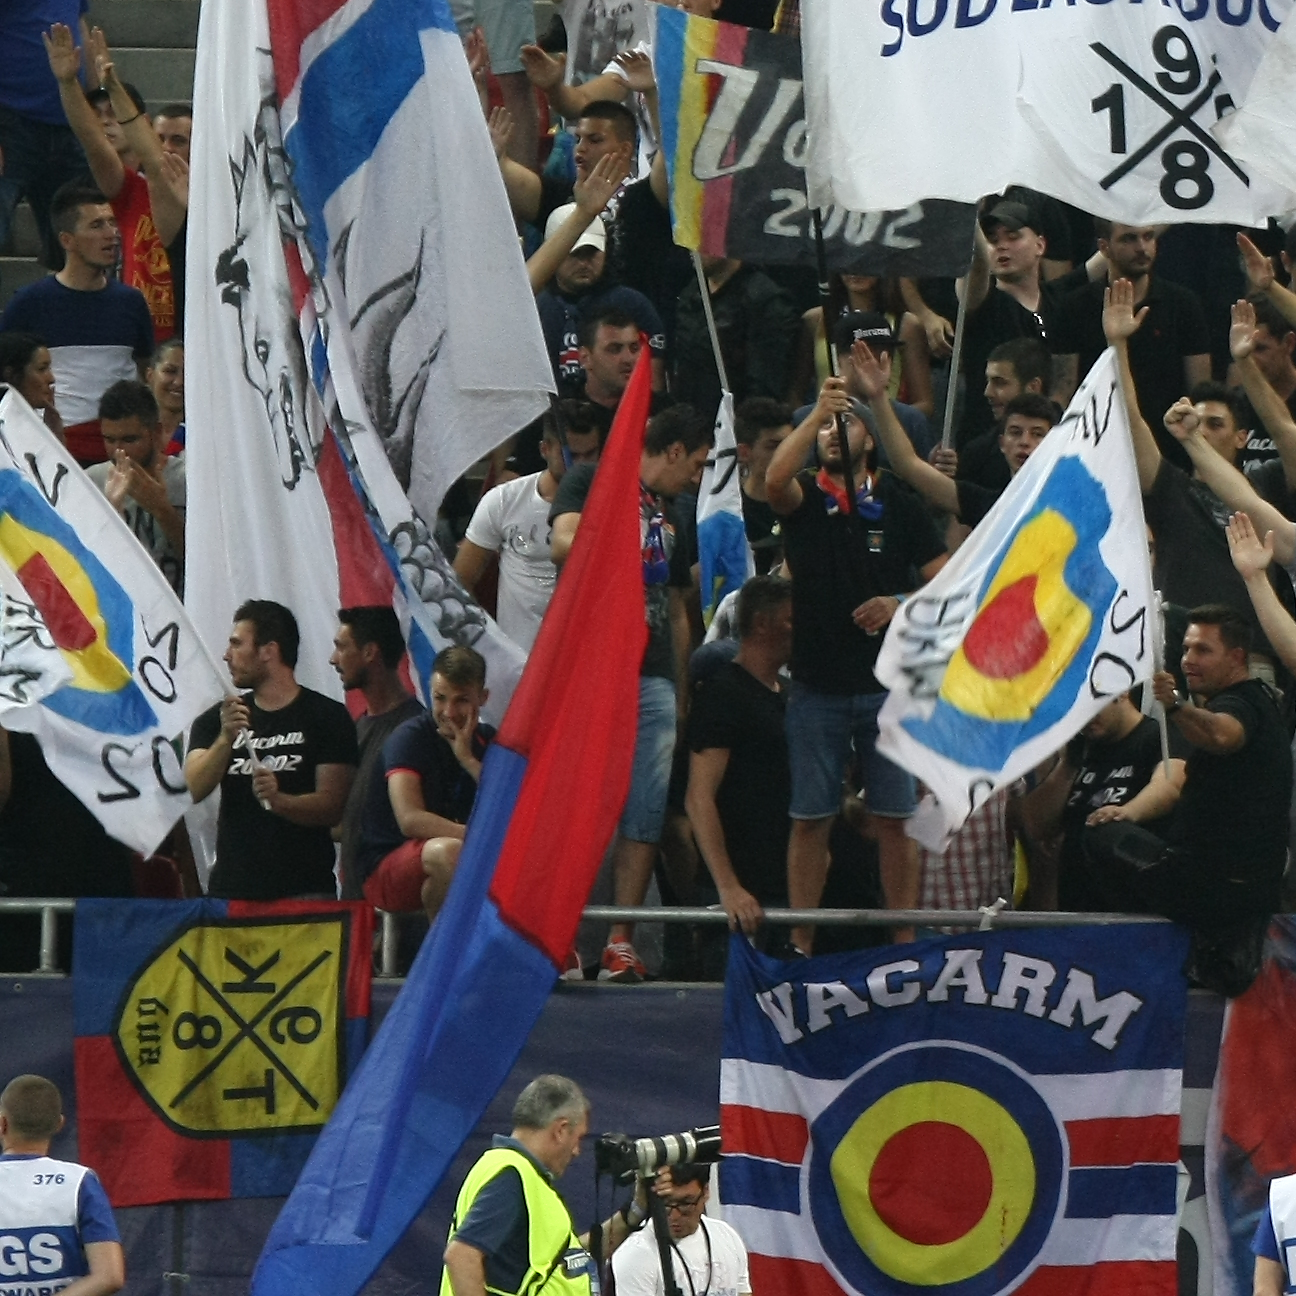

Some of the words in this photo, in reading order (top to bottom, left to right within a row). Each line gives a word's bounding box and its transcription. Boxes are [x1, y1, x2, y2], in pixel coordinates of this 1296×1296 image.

[755, 946, 1143, 1051] VACARM
[32, 1174, 67, 1186] 376
[0, 1232, 64, 1278] GS
